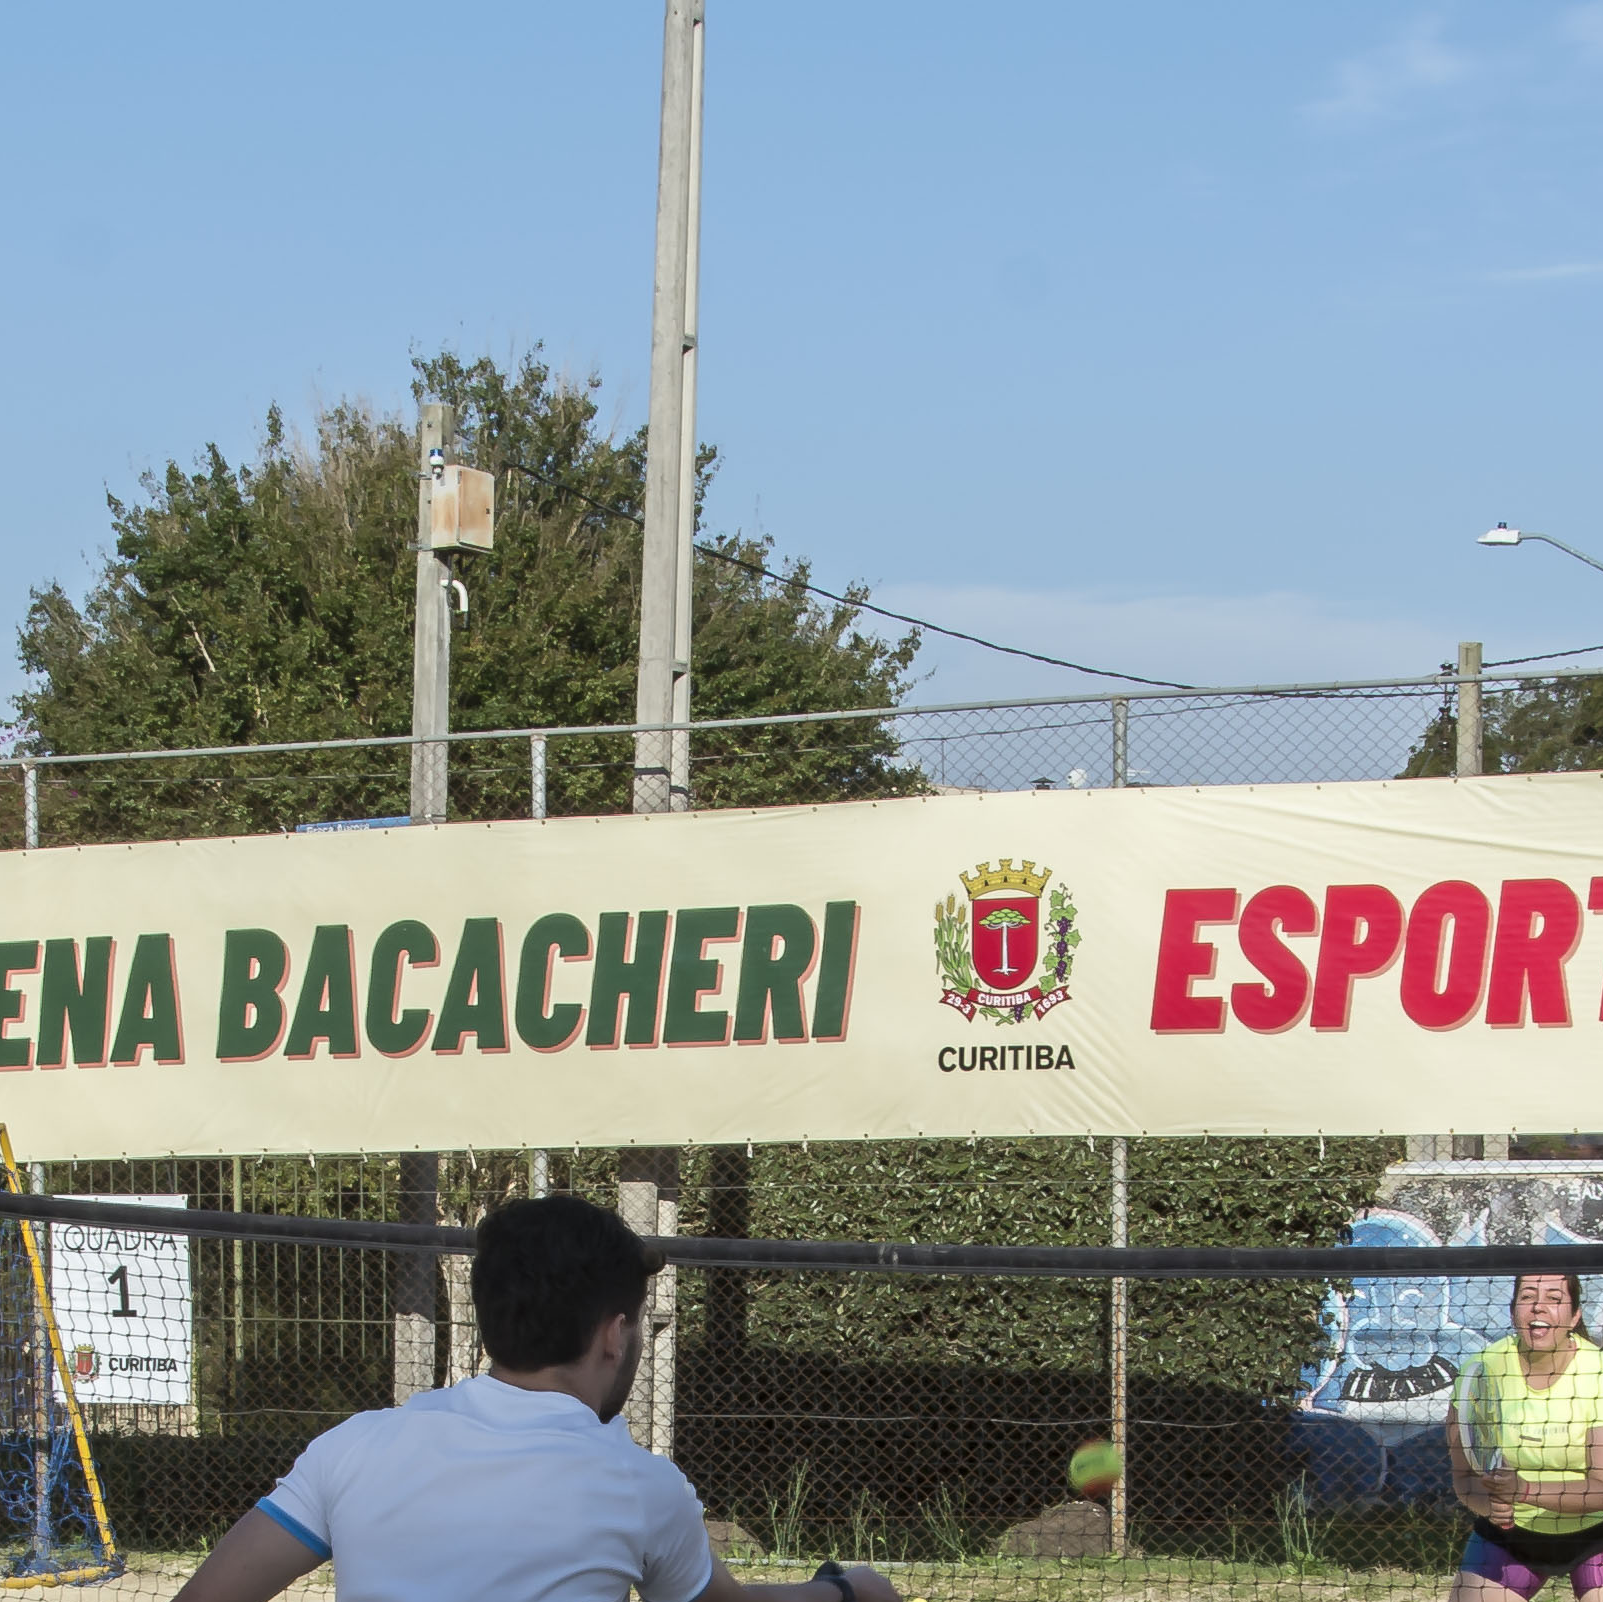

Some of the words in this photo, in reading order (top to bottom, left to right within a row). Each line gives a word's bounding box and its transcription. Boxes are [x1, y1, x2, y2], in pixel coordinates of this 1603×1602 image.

[216, 900, 861, 1061] BACACHERI
[948, 993, 972, 1014] 29-3
[977, 992, 1032, 1006] CURITIBA
[1036, 989, 1064, 1013] 1693
[938, 1045, 1076, 1072] CURITIBA
[63, 1225, 177, 1251] QUADRA
[108, 1266, 137, 1317] 1
[108, 1358, 178, 1373] CURITIBA
